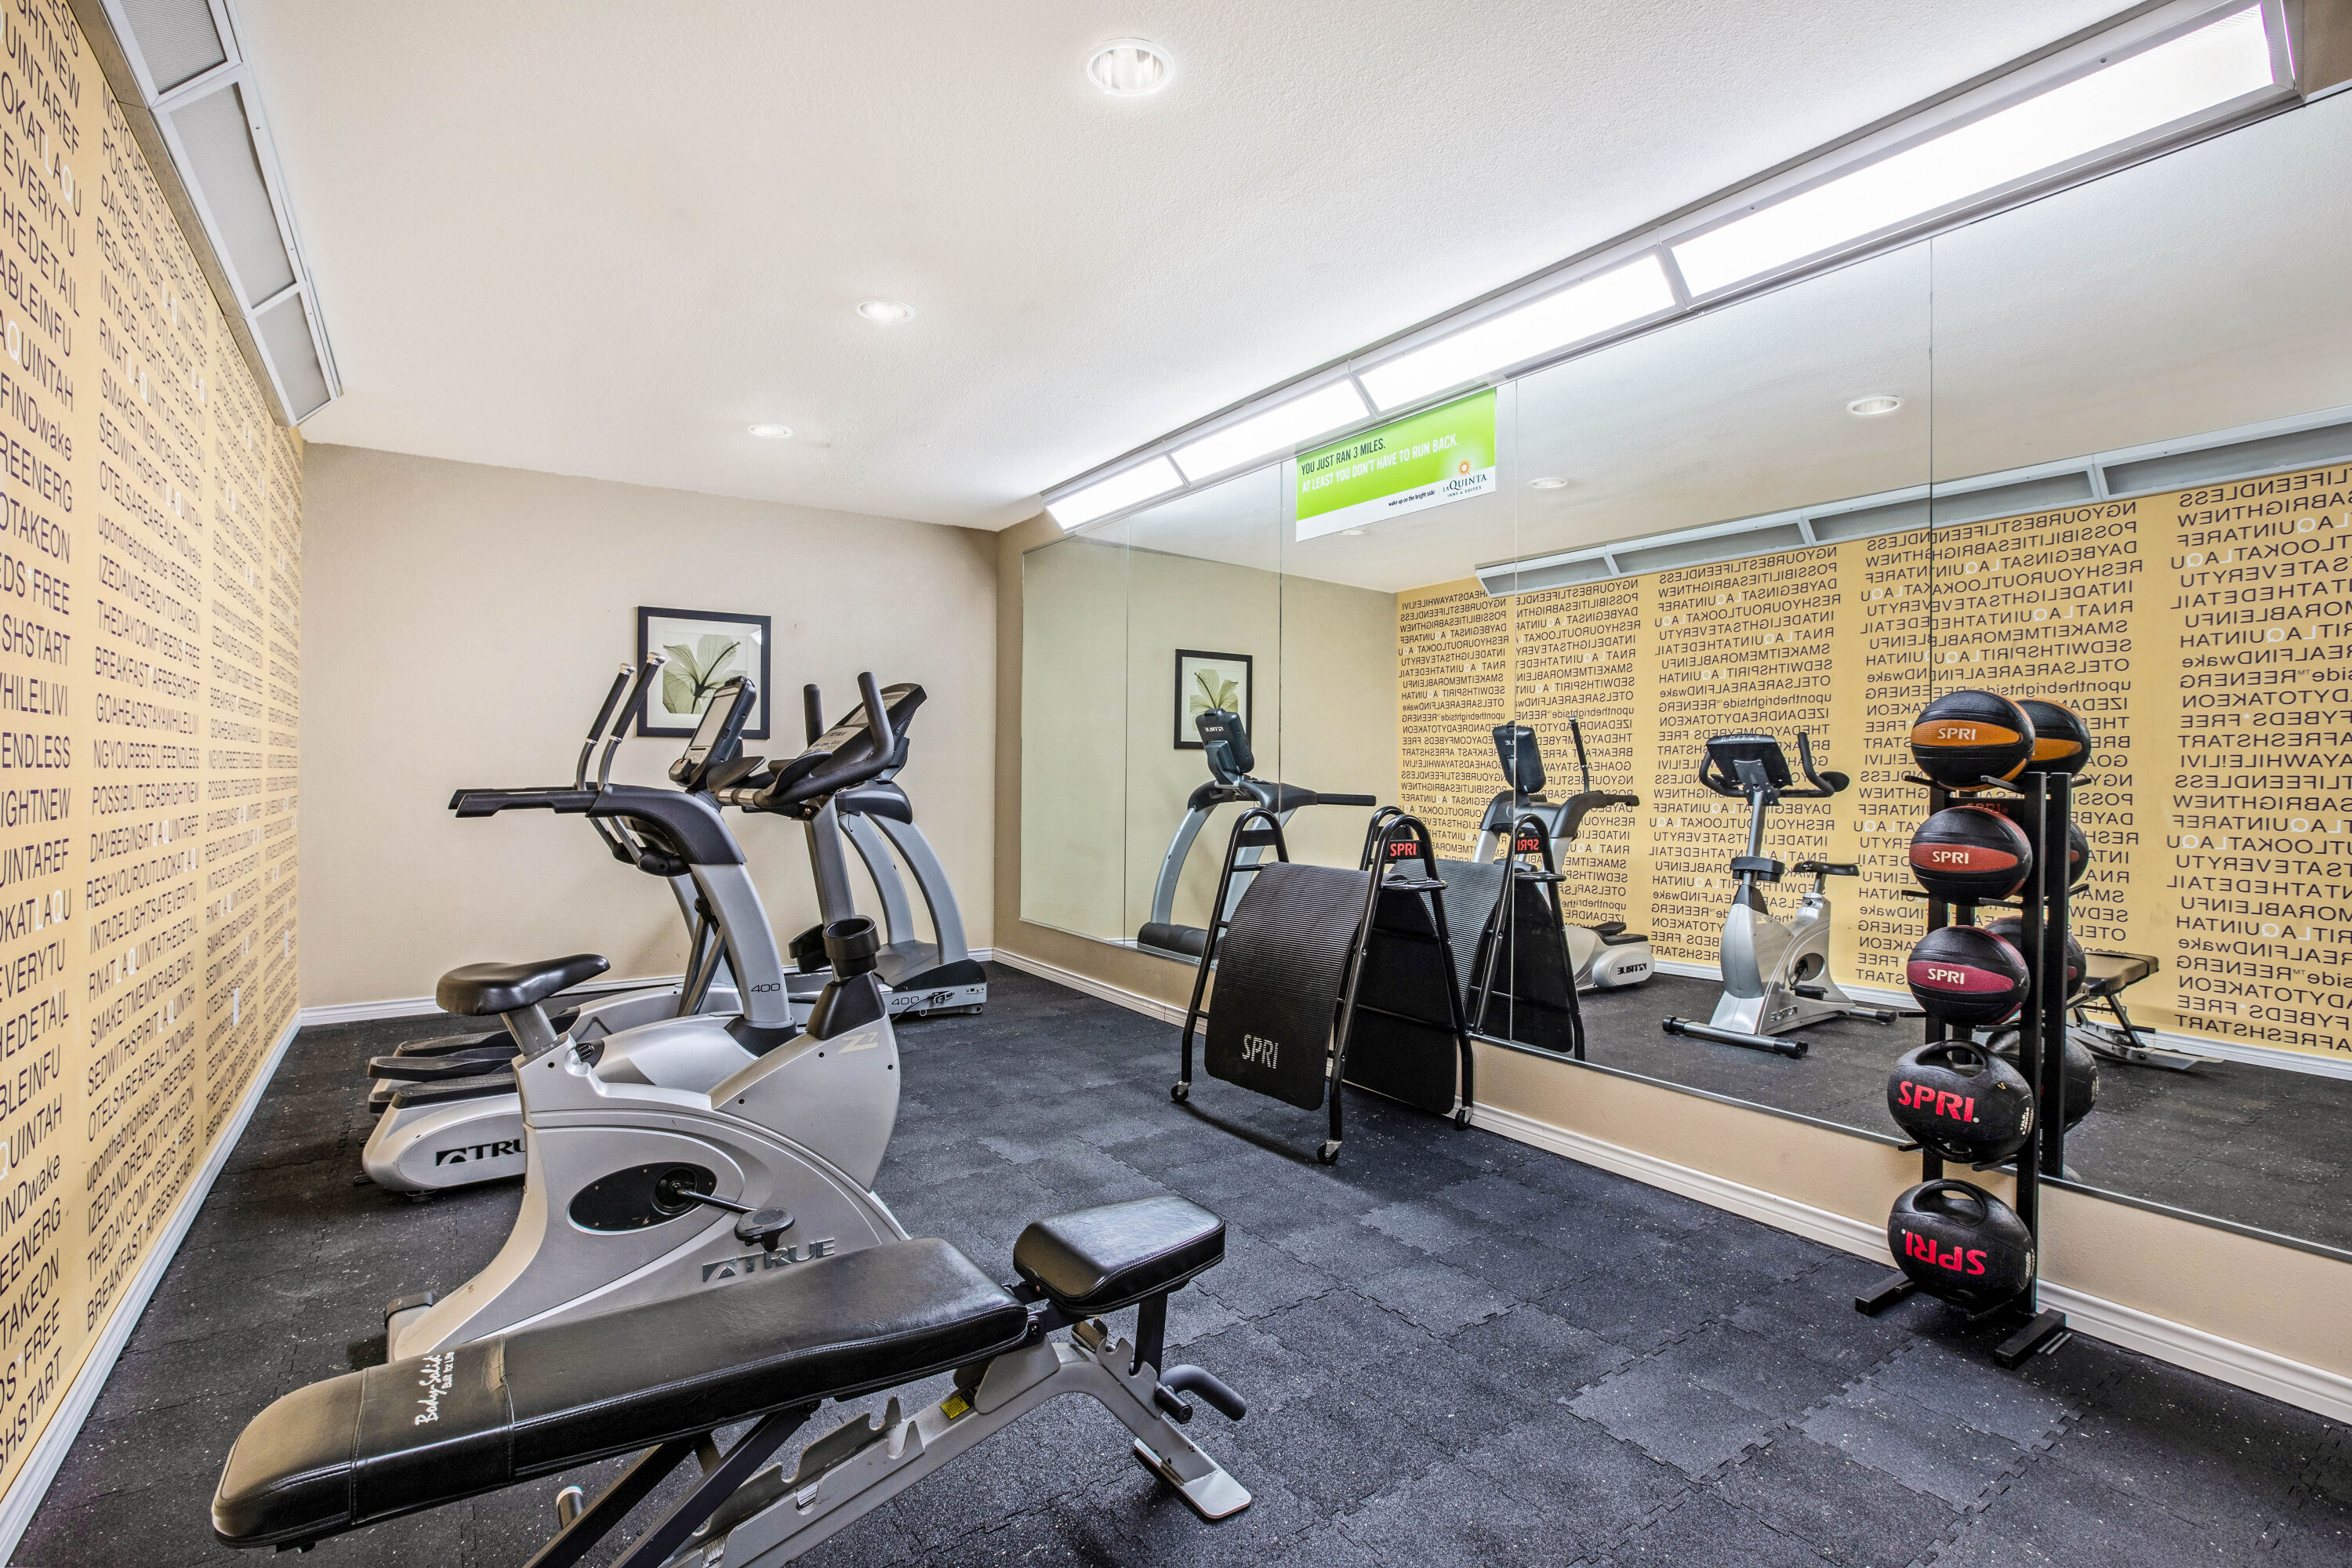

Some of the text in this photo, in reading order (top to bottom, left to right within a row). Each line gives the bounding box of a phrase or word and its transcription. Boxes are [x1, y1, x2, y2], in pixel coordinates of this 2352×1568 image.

[1301, 438, 1385, 475] YOU JUST RAN 3 MILES.
[1302, 434, 1459, 493] AT LEAST YOU DON'T HAVE TO RUN BACK.
[1415, 492, 1426, 500] bright
[1464, 485, 1482, 494] SUITES
[1937, 728, 1976, 741] SPRI
[1390, 842, 1417, 857] SPRI
[1932, 851, 1969, 864] SPRI
[1927, 968, 1965, 985] SPRI
[751, 983, 780, 993] 400
[1242, 1034, 1279, 1070] SPRI
